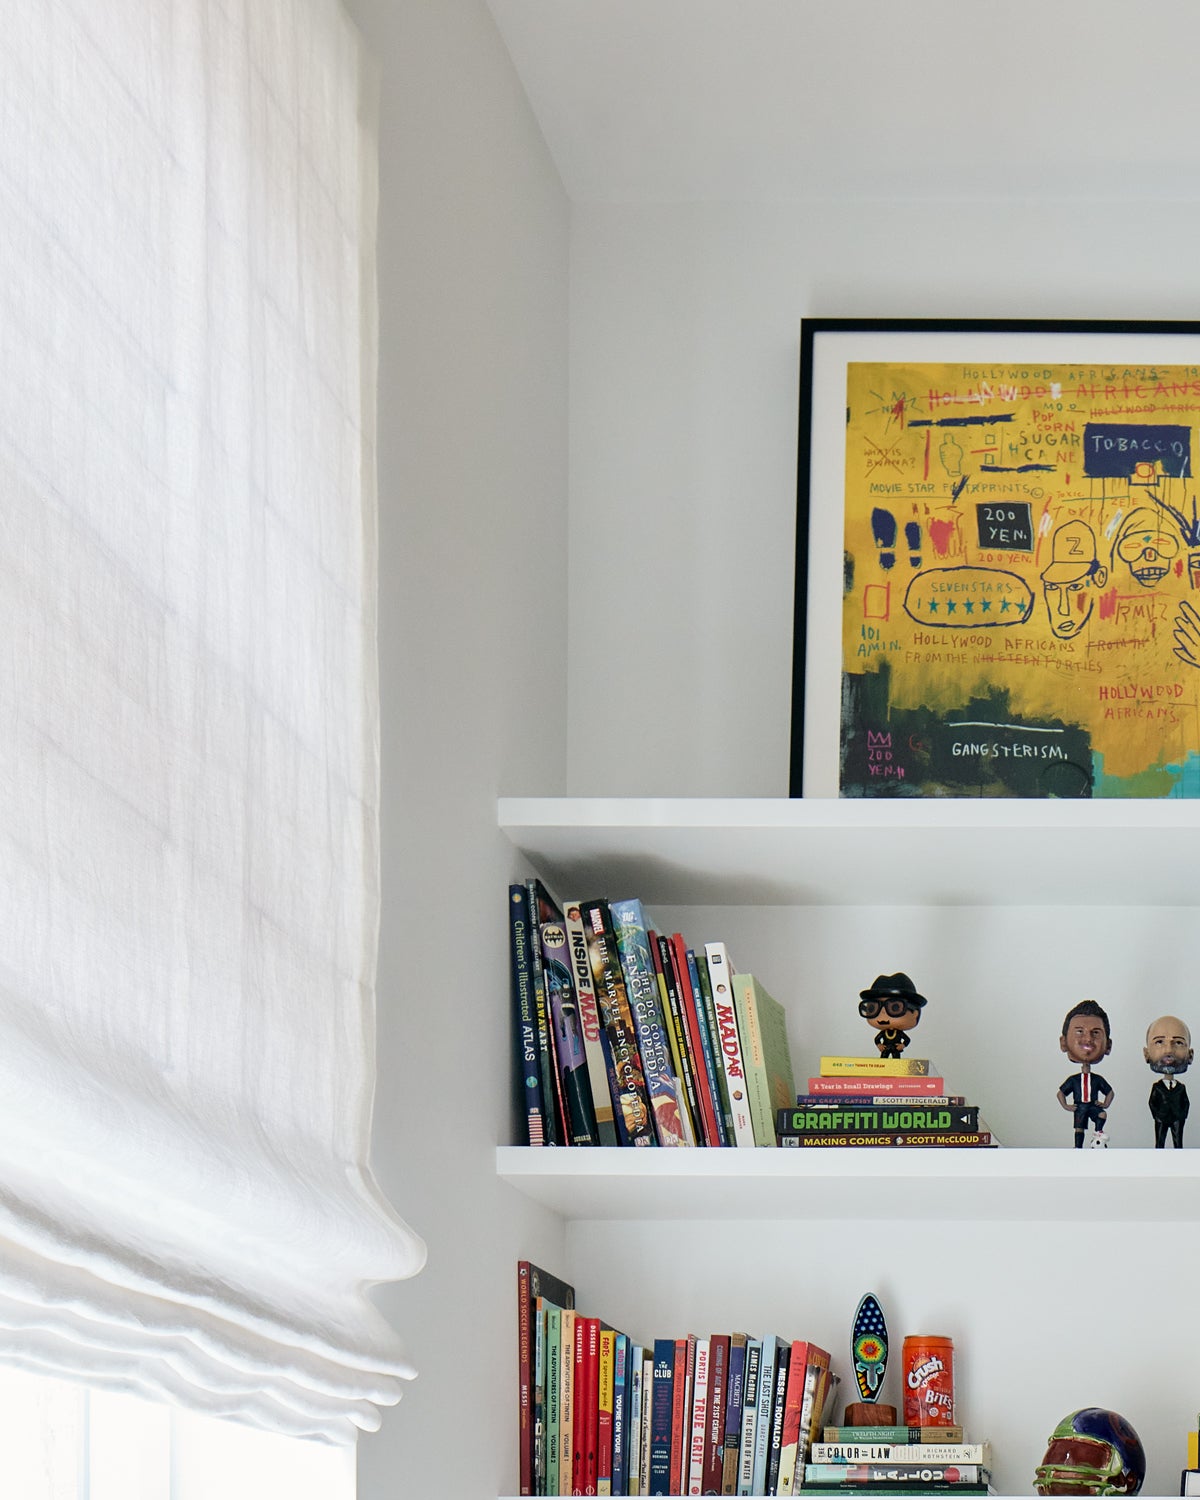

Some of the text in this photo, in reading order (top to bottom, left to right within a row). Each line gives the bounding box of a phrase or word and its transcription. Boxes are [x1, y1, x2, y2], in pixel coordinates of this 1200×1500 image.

[1018, 430, 1082, 447] SUGAR
[869, 481, 936, 494] MOVIE STAR
[982, 507, 1017, 521] 200
[1065, 536, 1084, 556] Z
[913, 631, 1076, 653] HOLLYWOOD AFRICANS
[1099, 684, 1184, 701] HOLLYWOOD
[589, 907, 605, 936] MARVEL
[514, 920, 536, 1062] Children's Illustrated ATLAS
[571, 930, 600, 1042] INSIDE MAD
[626, 953, 661, 1091] ENCYCLOPEDIA
[640, 969, 666, 1072] THE DC COMICS
[597, 937, 645, 1133] THE MARVEL ENCYCLOPEDIA
[715, 1003, 739, 1057] MAD
[727, 1056, 743, 1079] ART
[863, 1083, 893, 1091] Drawings
[905, 1097, 947, 1105] FITZGERALD
[792, 1111, 952, 1130] GRAFFITI WORLD
[803, 1136, 980, 1147] MAKING COMICS SCOTT McCLOUD
[602, 1337, 610, 1357] FARTS
[654, 1369, 672, 1378] CLUB
[699, 1351, 707, 1383] PORTIS
[716, 1367, 722, 1375] OF
[747, 1350, 759, 1402] JAMES McBRIDE
[763, 1365, 772, 1379] THE
[907, 1356, 944, 1389] Crush
[733, 1374, 741, 1408] MACBETH
[761, 1380, 771, 1398] LAST
[712, 1405, 720, 1419] 21ST
[760, 1399, 770, 1418] SHOT
[772, 1367, 786, 1449] MESSI RONALDO
[615, 1421, 622, 1433] ON
[692, 1398, 706, 1464] TRUE GRIT
[711, 1419, 720, 1444] CENTURY
[745, 1428, 753, 1447] COLOR
[744, 1449, 751, 1458] OF
[827, 1447, 891, 1459] COLOR LAW
[743, 1460, 751, 1480] WATER
